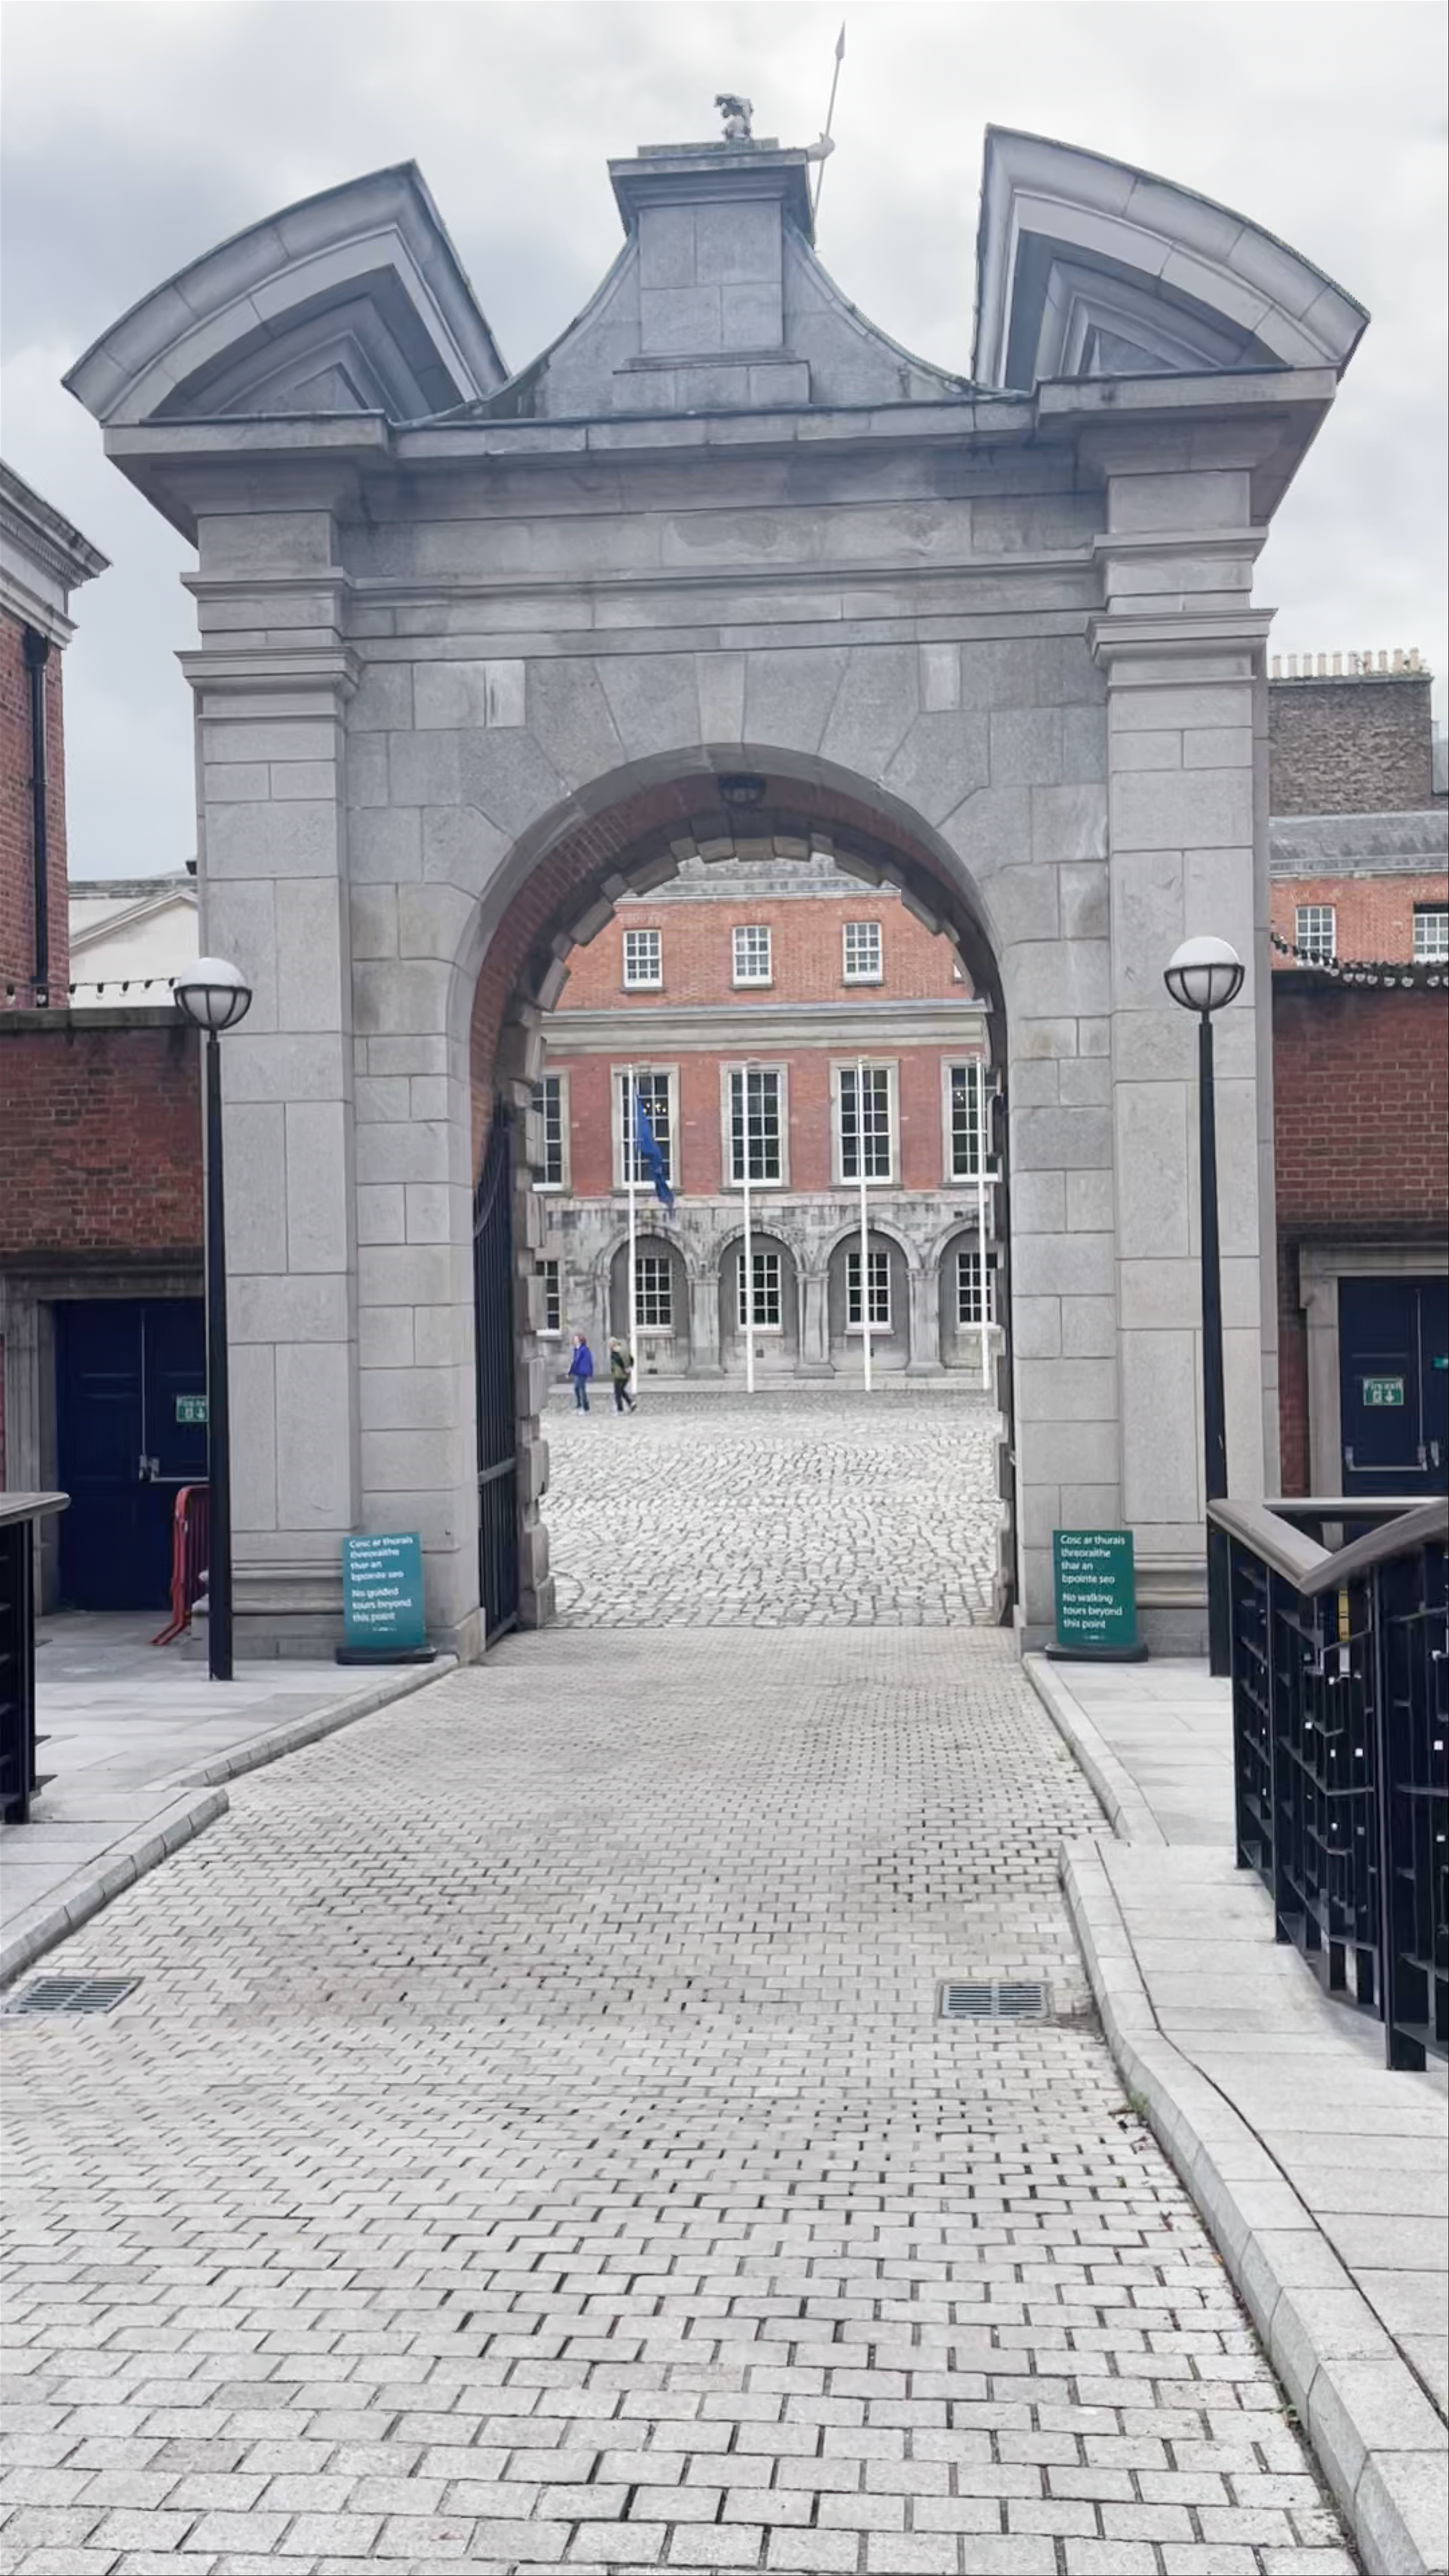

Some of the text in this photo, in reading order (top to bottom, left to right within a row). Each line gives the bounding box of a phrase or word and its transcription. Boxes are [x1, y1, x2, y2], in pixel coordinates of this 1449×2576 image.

[1060, 1535, 1081, 1544] Cosc
[1094, 1535, 1125, 1545] thurais
[1061, 1561, 1080, 1570] thar
[1061, 1574, 1098, 1584] bpointe
[1063, 1593, 1113, 1604] No walking
[376, 1598, 412, 1610] beyond
[1063, 1606, 1123, 1617] tours beyond
[1063, 1619, 1106, 1629] this point
